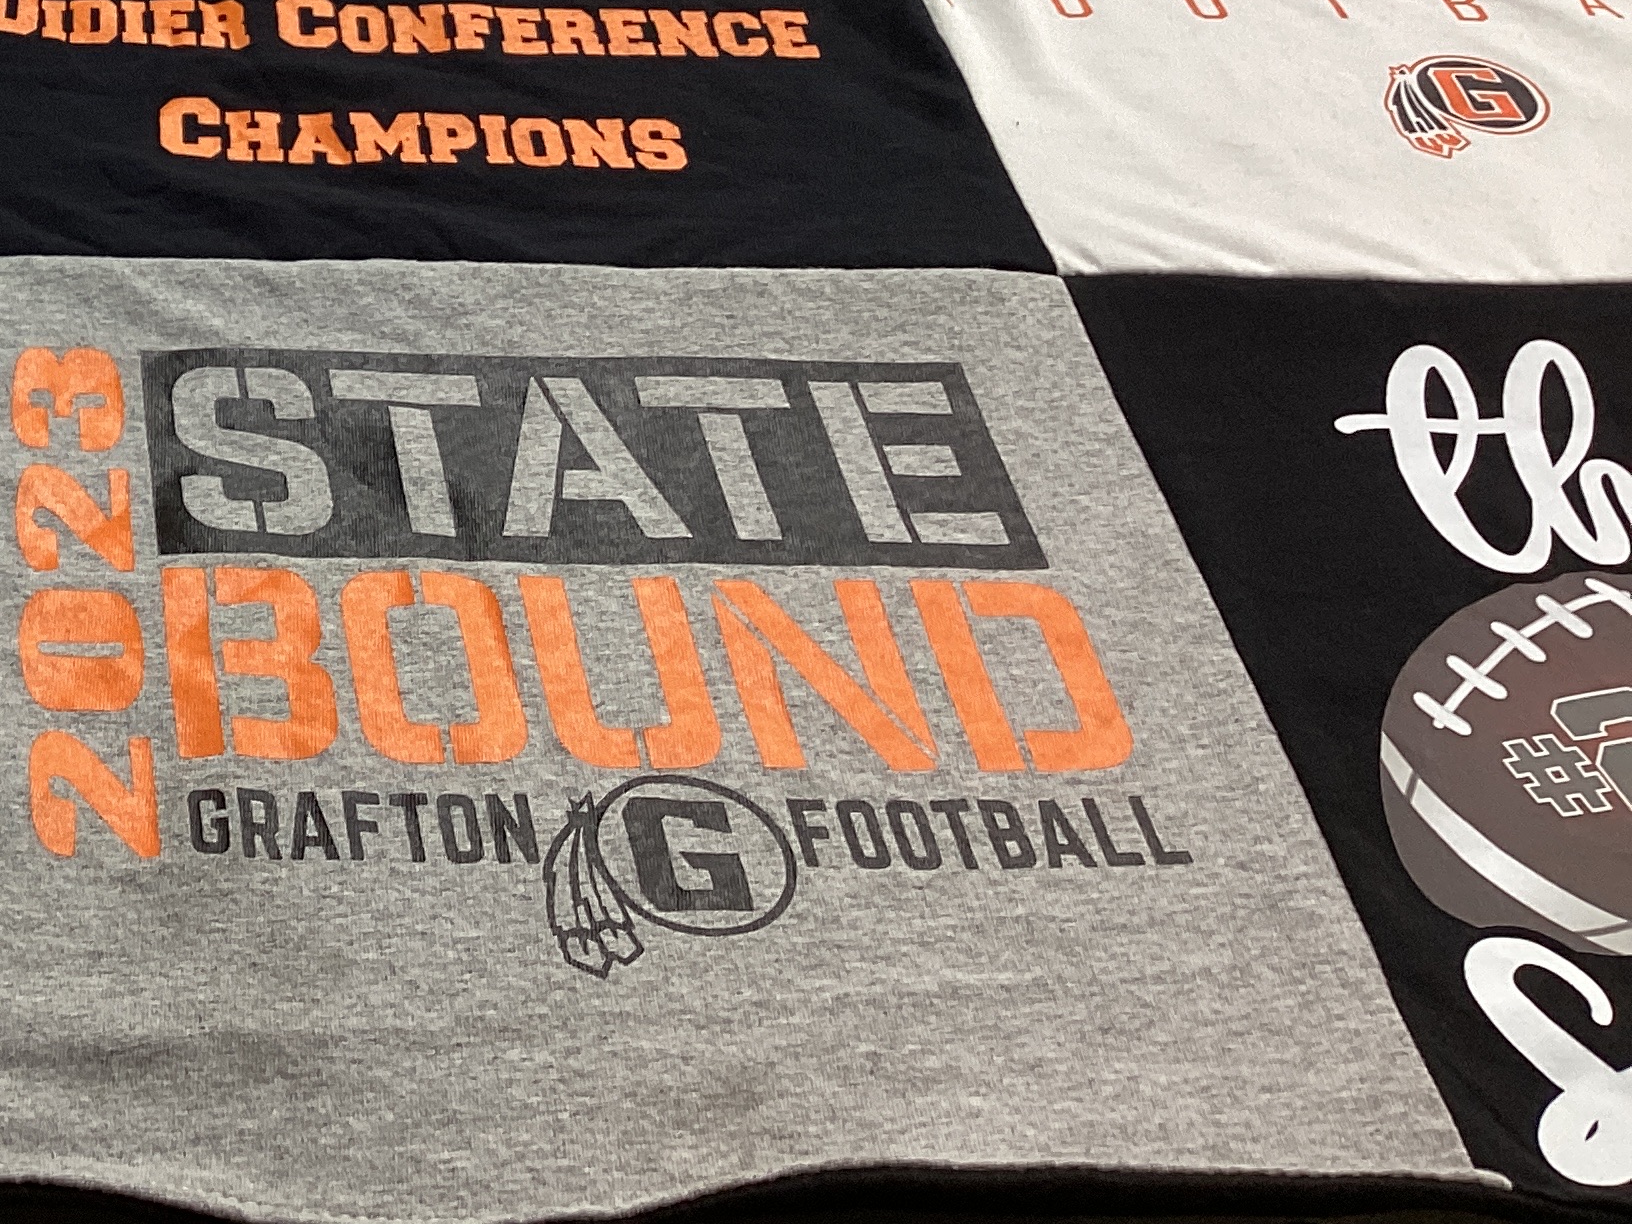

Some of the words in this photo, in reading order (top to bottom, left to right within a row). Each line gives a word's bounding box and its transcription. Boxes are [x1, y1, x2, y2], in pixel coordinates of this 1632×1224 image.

[160, 97, 688, 171] CHAMPIONS
[167, 365, 1013, 547] STATE
[10, 345, 162, 859] 2023
[162, 564, 1134, 774] BOUND
[186, 787, 541, 867] GRAFTON
[800, 796, 1194, 868] FOOTBALL
